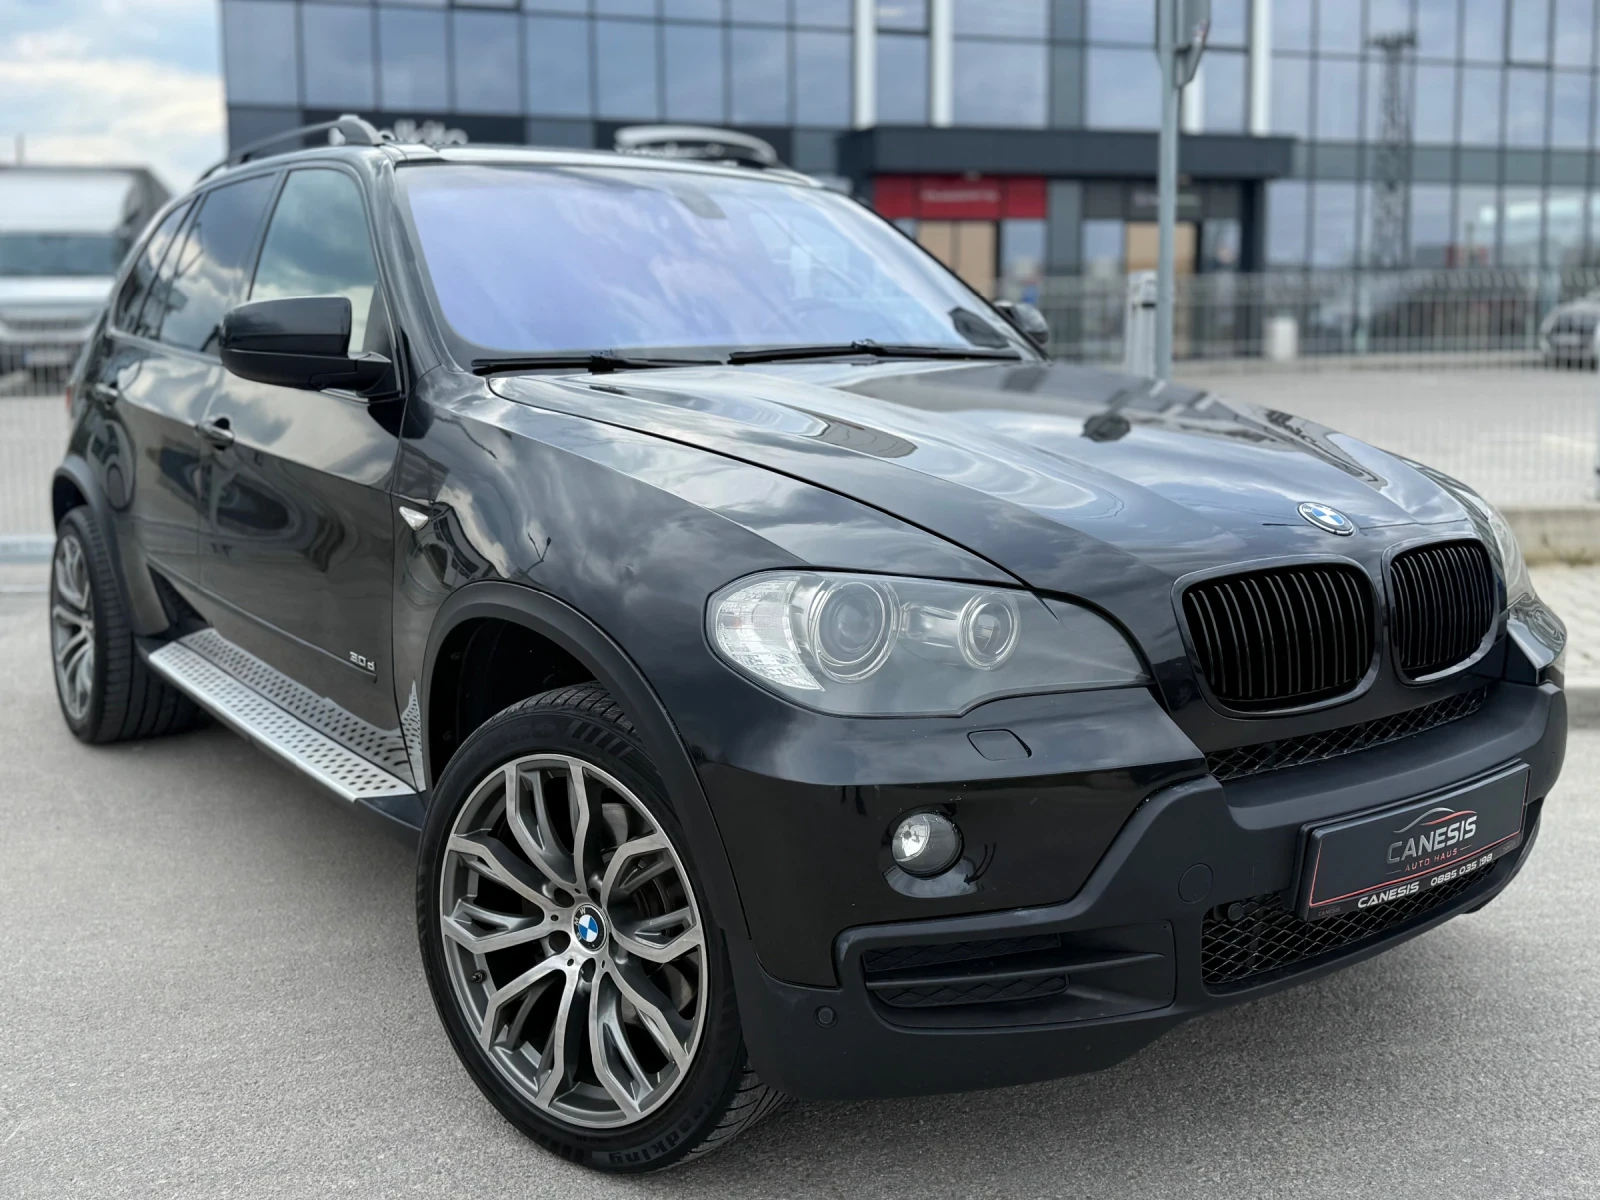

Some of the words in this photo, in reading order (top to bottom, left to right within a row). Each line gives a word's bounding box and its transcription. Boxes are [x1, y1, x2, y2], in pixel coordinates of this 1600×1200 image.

[1386, 815, 1478, 865] CANESIS
[1404, 858, 1430, 873] AUTO
[1434, 847, 1458, 863] HAUS
[1357, 881, 1420, 908] CANESIS
[1430, 869, 1457, 886] 0885
[1458, 860, 1477, 875] 035
[1479, 852, 1493, 867] 198
